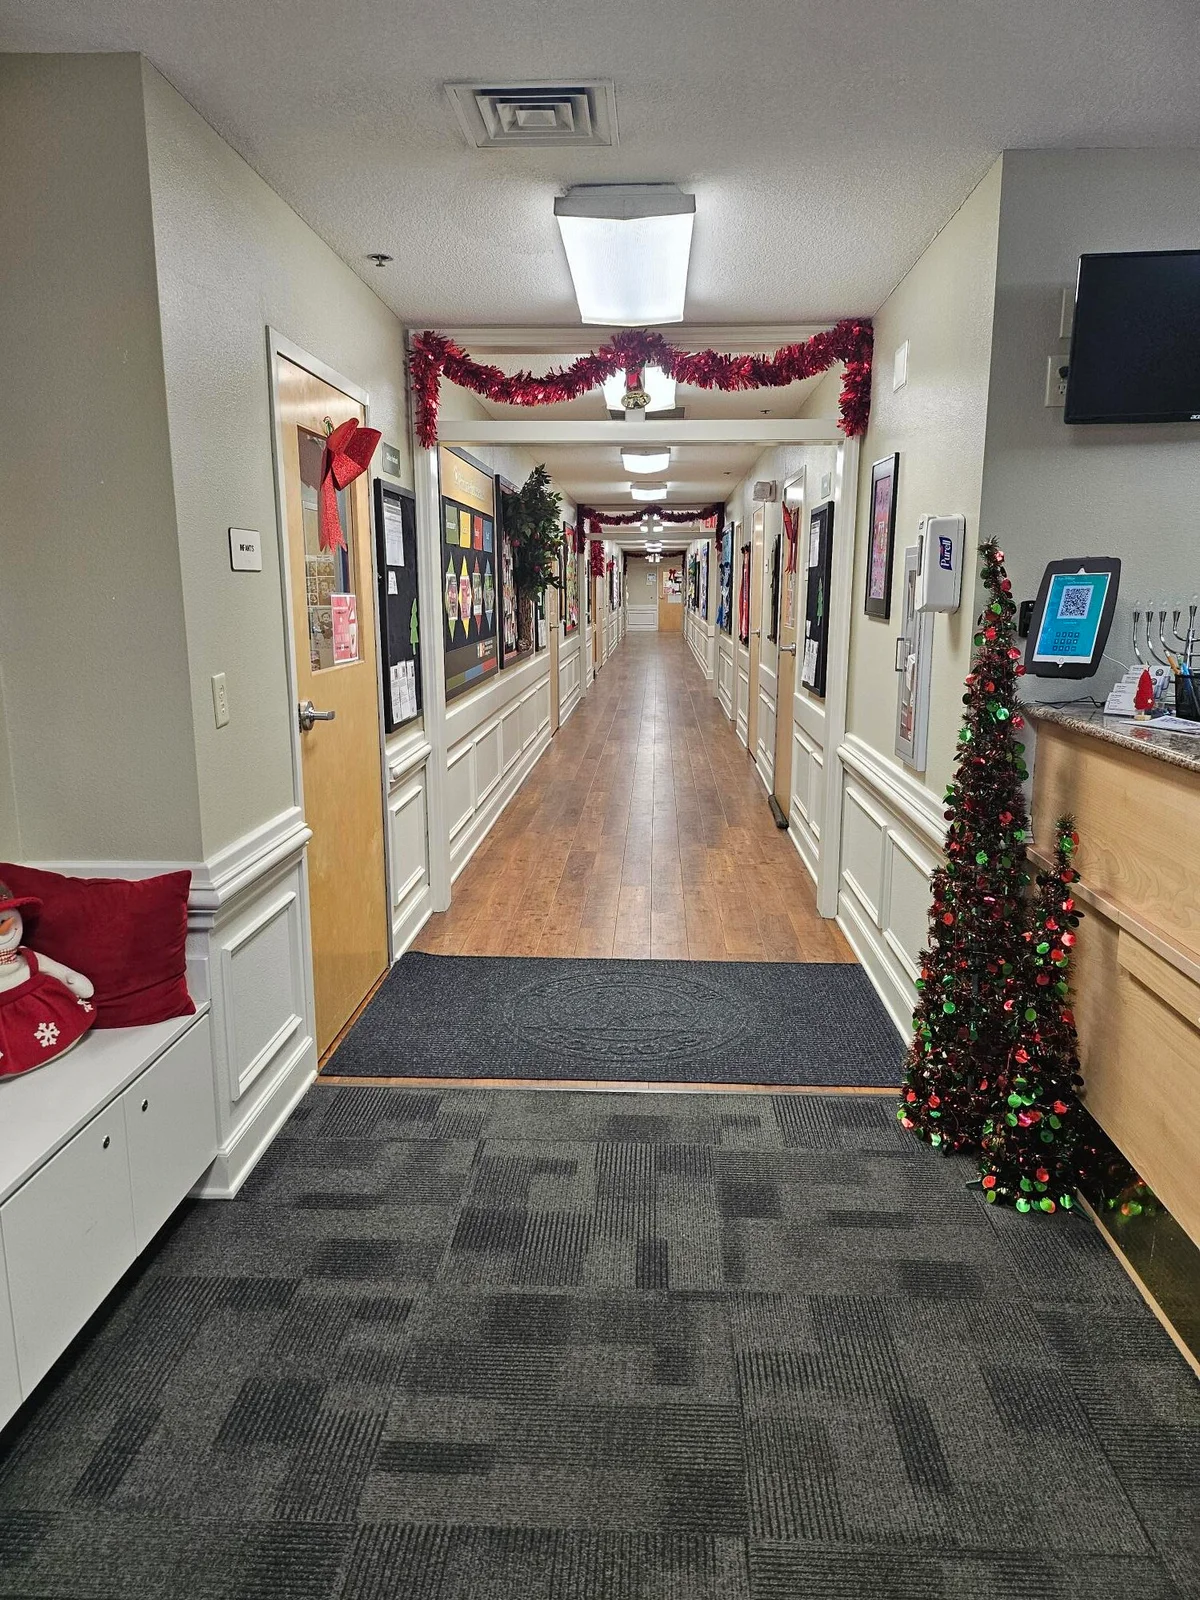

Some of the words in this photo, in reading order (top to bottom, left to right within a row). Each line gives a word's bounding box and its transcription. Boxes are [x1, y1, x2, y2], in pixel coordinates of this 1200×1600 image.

[705, 515, 718, 528] EXI
[239, 543, 255, 552] INFANTS
[940, 540, 951, 566] Purell
